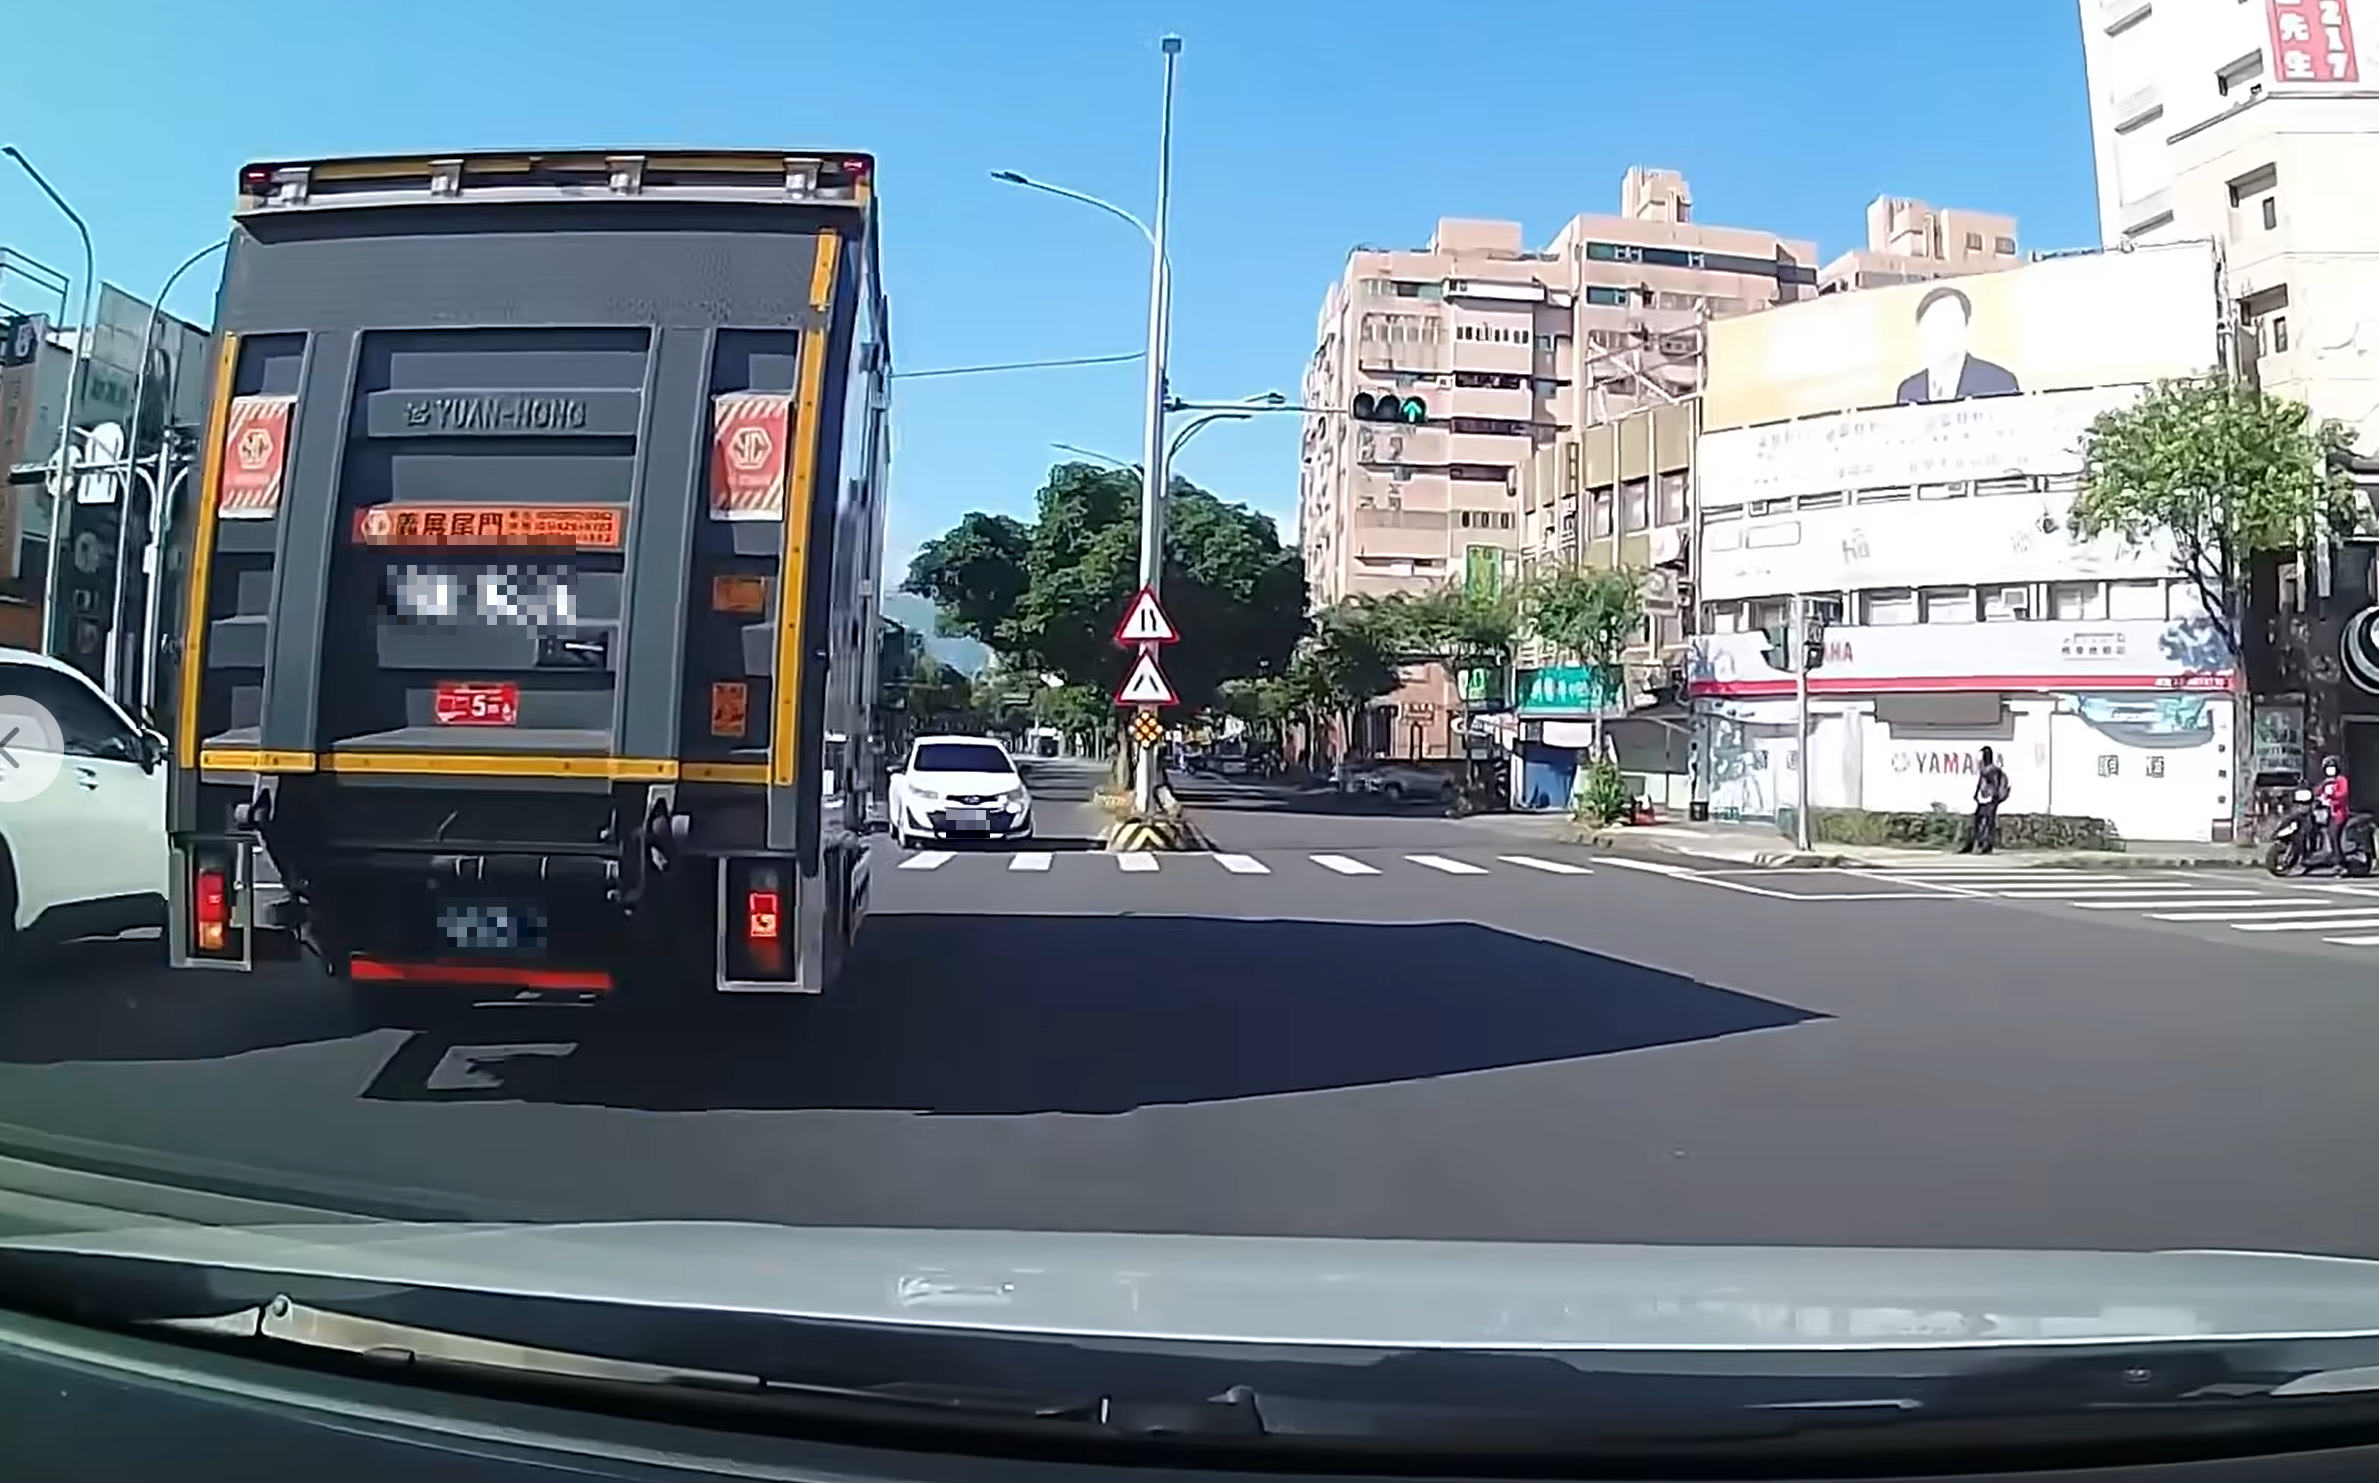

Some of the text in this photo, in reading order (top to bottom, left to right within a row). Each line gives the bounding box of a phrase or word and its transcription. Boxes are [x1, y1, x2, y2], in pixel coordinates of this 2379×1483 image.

[2276, 0, 2315, 78] 先生
[435, 398, 587, 429] YUAN-HONG
[1915, 752, 2004, 775] YAMAA
